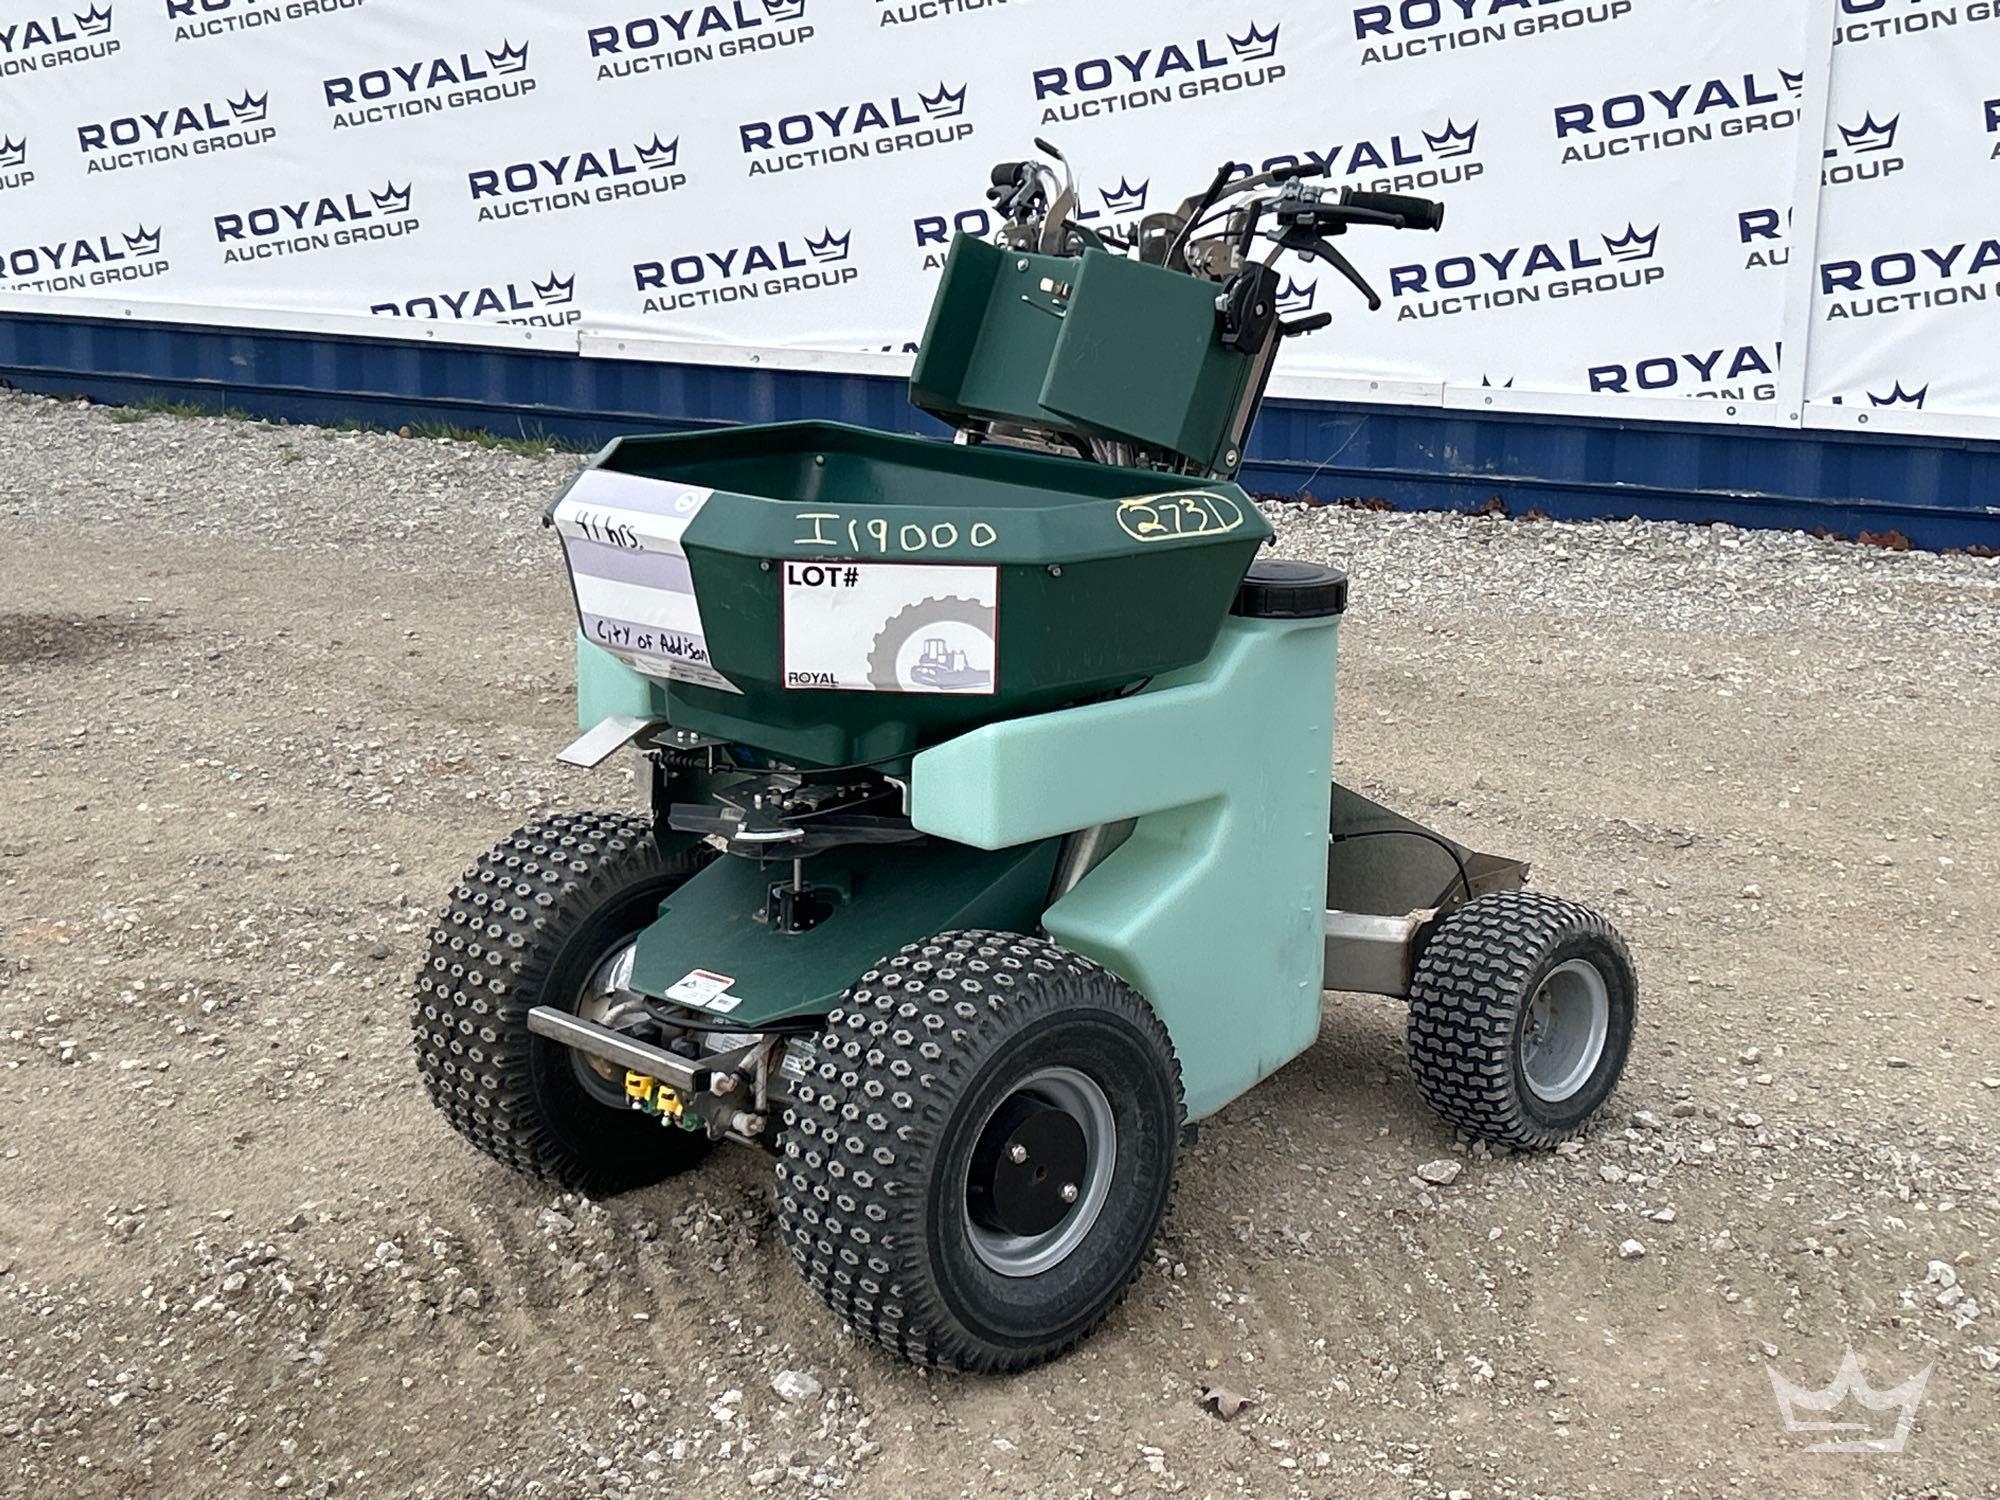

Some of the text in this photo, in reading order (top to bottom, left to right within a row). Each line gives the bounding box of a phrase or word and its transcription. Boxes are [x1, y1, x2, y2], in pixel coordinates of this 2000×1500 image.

[174, 7, 282, 42] AUCTION
[588, 0, 763, 58] ROYAL
[1361, 0, 1632, 66] AUCTION GROUP
[41, 40, 121, 68] GROUP
[597, 25, 815, 81] AUCTION GROUP
[1033, 39, 1229, 101] ROYAL
[323, 53, 488, 108] ROYAL
[332, 78, 537, 130] AUCTION GROUP
[1040, 65, 1286, 125] AUCTION GROUP
[78, 103, 231, 153] ROYAL
[739, 97, 921, 154] ROYAL
[1554, 73, 1779, 139] ROYAL
[87, 126, 277, 175] AUCTION GROUP
[748, 123, 974, 177] AUCTION GROUP
[1561, 123, 1713, 165] AUCTION
[469, 148, 637, 200] ROYAL
[477, 174, 687, 222] AUCTION GROUP
[214, 193, 373, 243] ROYAL
[223, 218, 420, 264] AUCTION GROUP
[0, 236, 126, 279] OYAL
[89, 260, 170, 286] GROUP
[633, 240, 807, 292] ROYAL
[1390, 238, 1603, 298] ROYAL
[642, 267, 858, 314] AUCTION GROUP
[1397, 267, 1665, 322] AUCTION GROUP
[1826, 283, 1987, 322] AUCTION
[1587, 341, 1783, 394] ROYA
[1129, 498, 1229, 533] 2731
[787, 564, 860, 588] LOT#
[597, 620, 630, 646] City
[788, 672, 840, 685] ROYAL
